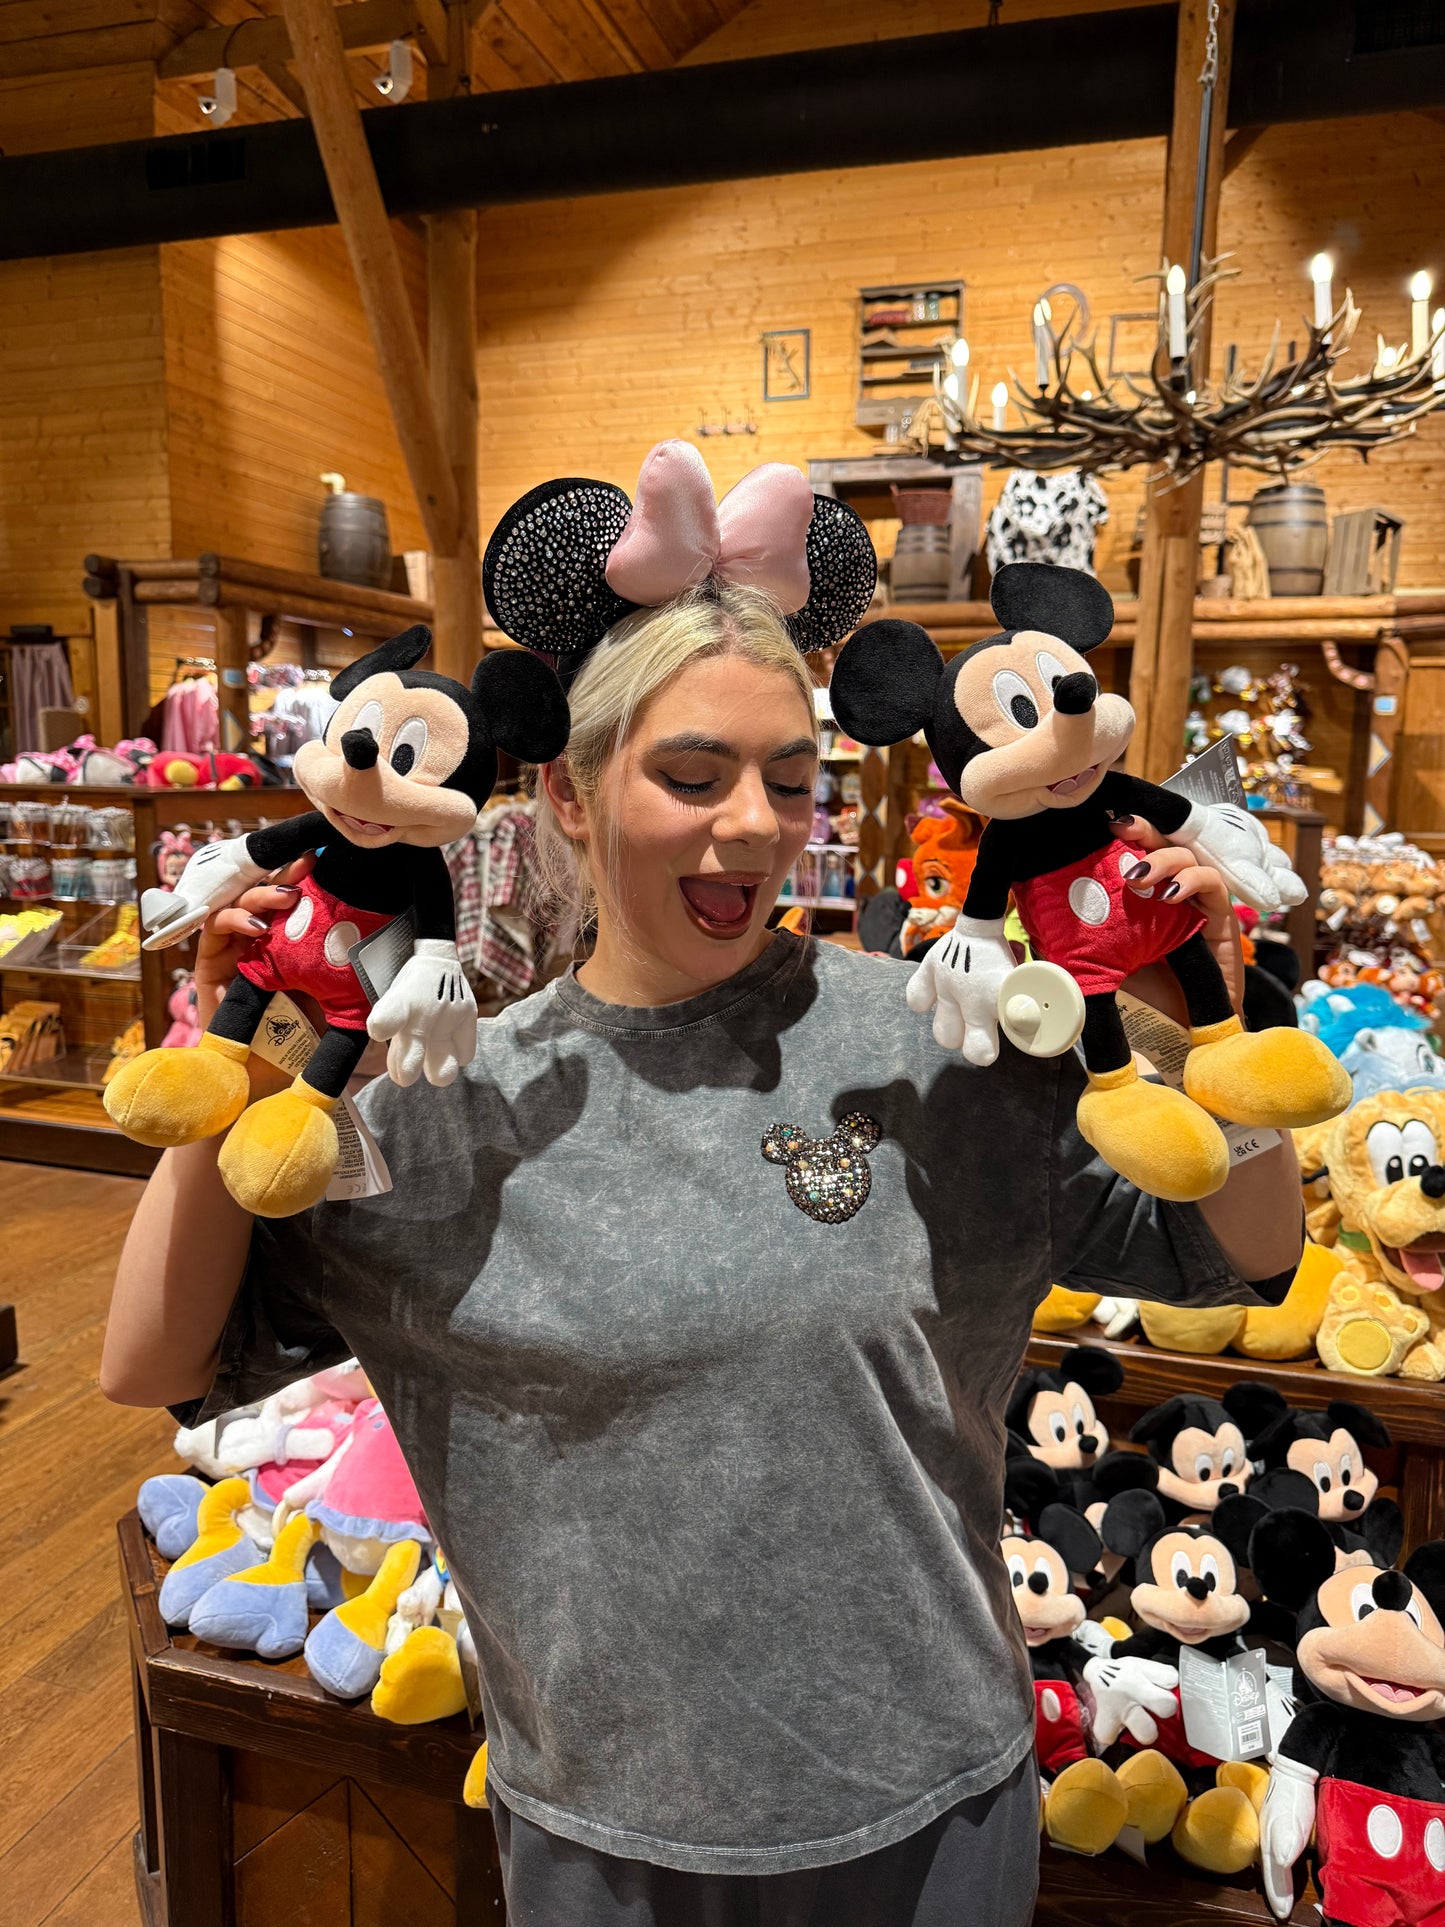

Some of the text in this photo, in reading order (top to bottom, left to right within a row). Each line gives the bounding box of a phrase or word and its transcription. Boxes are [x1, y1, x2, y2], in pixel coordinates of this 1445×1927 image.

[267, 1019, 302, 1047] Disney
[1244, 1138, 1260, 1152] CE
[1230, 1690, 1260, 1706] Disney
